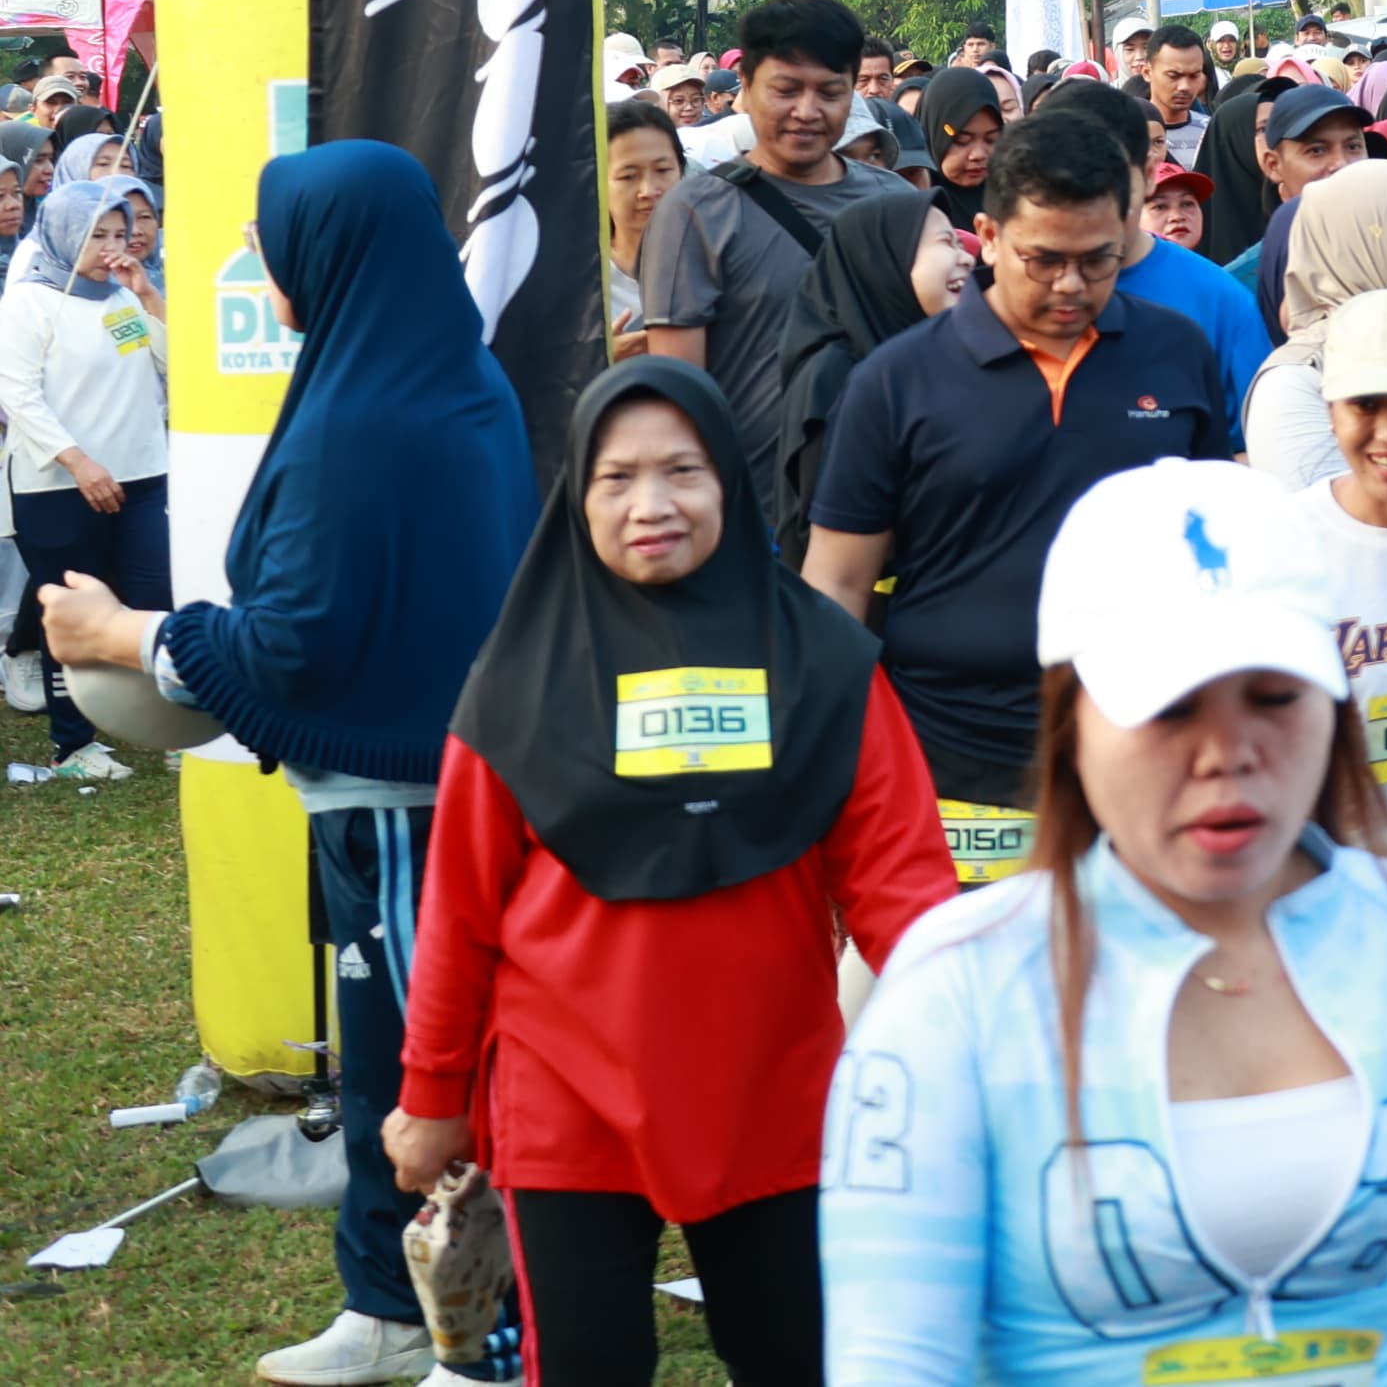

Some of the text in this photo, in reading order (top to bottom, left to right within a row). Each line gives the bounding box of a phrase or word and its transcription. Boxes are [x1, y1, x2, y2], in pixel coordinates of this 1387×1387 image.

[221, 351, 273, 369] KOTA
[640, 705, 747, 738] 0136
[943, 827, 1024, 851] 0150
